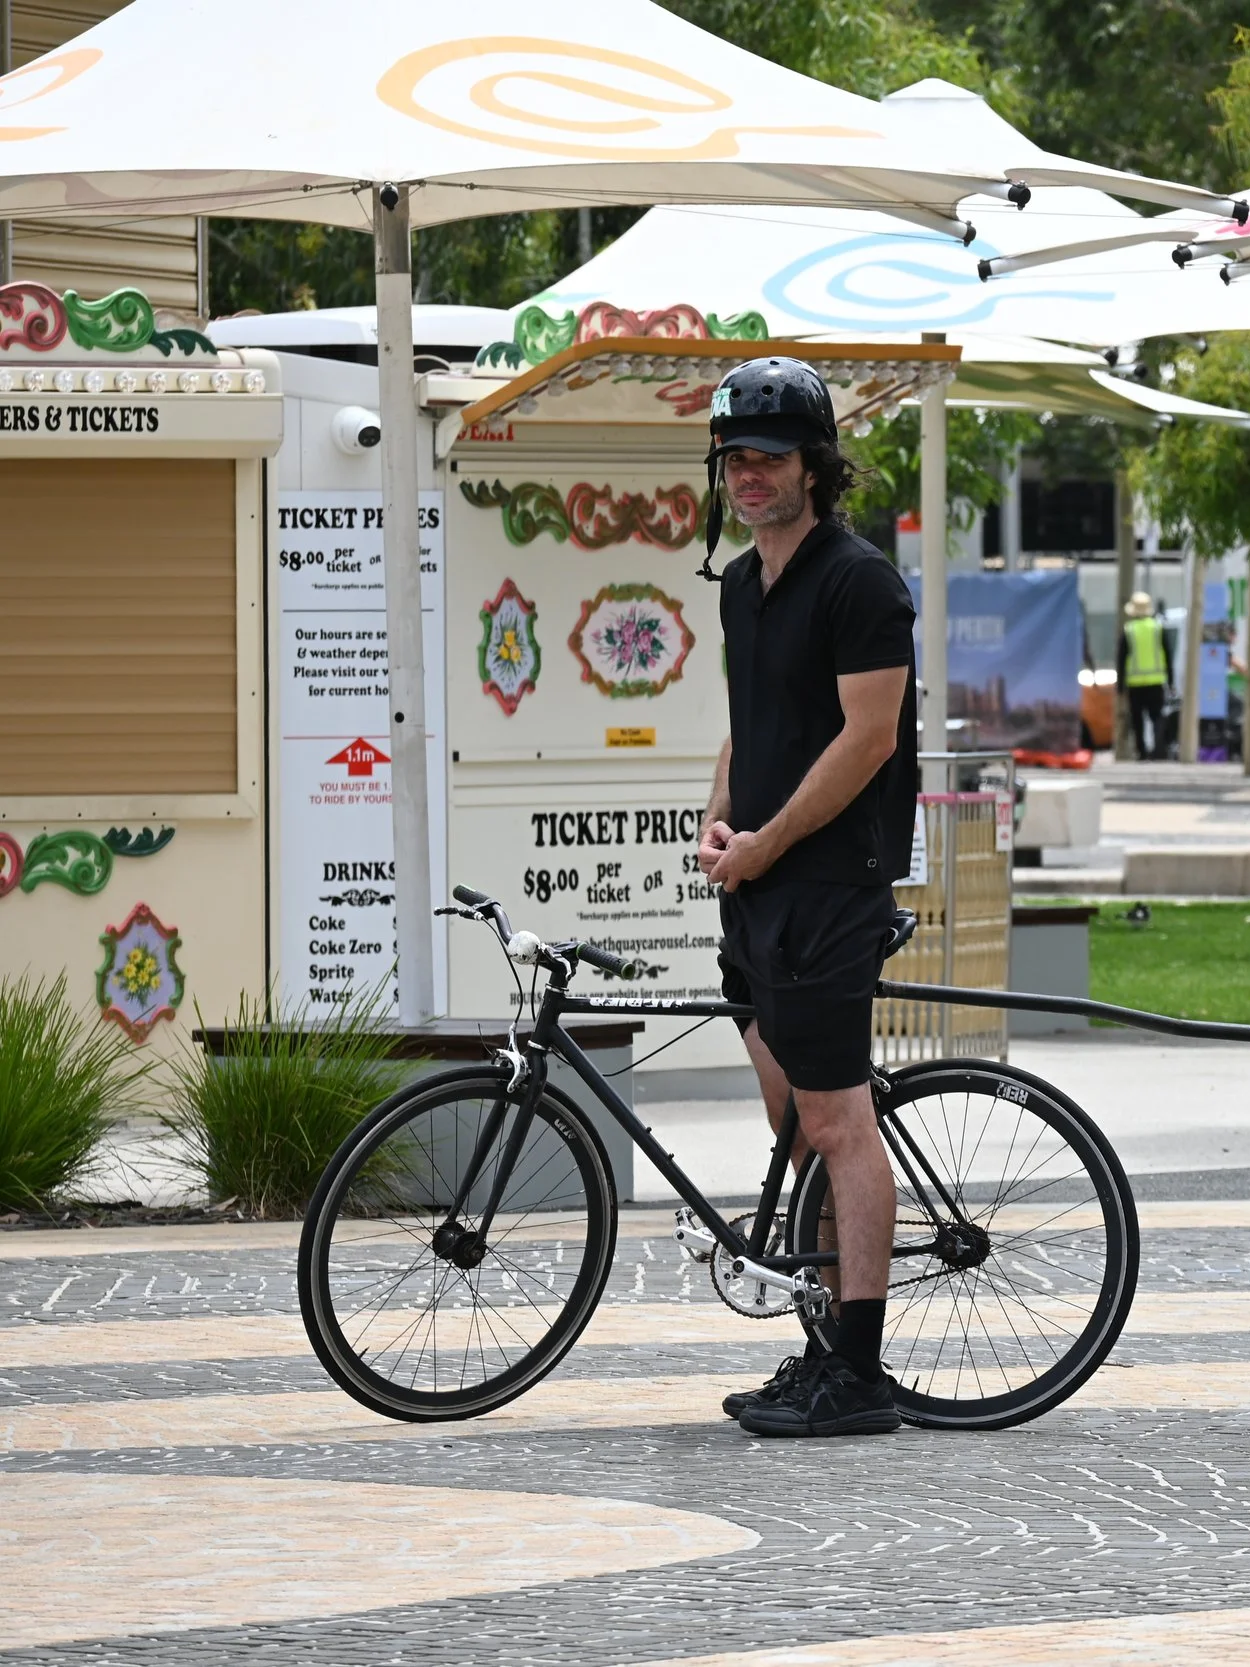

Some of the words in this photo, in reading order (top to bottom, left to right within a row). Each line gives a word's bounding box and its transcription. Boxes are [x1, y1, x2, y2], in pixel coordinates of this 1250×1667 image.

[44, 404, 62, 432] &
[66, 405, 159, 432] TICKETS
[278, 508, 358, 529] TICKET
[279, 549, 324, 571] $8.00
[334, 547, 355, 560] per
[326, 560, 362, 573] ticket
[295, 629, 318, 640] Our
[320, 629, 352, 640] hours
[355, 631, 373, 640] are
[310, 648, 357, 659] weather
[293, 666, 328, 678] Please
[331, 666, 357, 678] visit
[359, 668, 379, 678] our
[308, 685, 325, 696] for
[329, 686, 372, 696] current
[345, 749, 375, 762] 1.1m
[320, 782, 339, 792] YOU
[341, 782, 366, 791] MUST
[368, 781, 381, 791] BE
[310, 794, 322, 804] TO
[324, 794, 345, 804] RIDE
[348, 794, 360, 804] BY
[531, 811, 628, 847] TICKET
[634, 808, 706, 845] PRIC
[596, 860, 622, 882] per
[523, 866, 579, 903] $8.00
[643, 870, 664, 893] OR
[586, 882, 631, 904] ticket
[675, 883, 684, 903] 3
[687, 880, 721, 900] tick
[309, 915, 346, 931] Coke
[309, 939, 346, 955] Coke
[349, 939, 382, 955] Zero
[309, 964, 355, 982] Sprite
[309, 988, 353, 1003] Water
[655, 984, 686, 999] current
